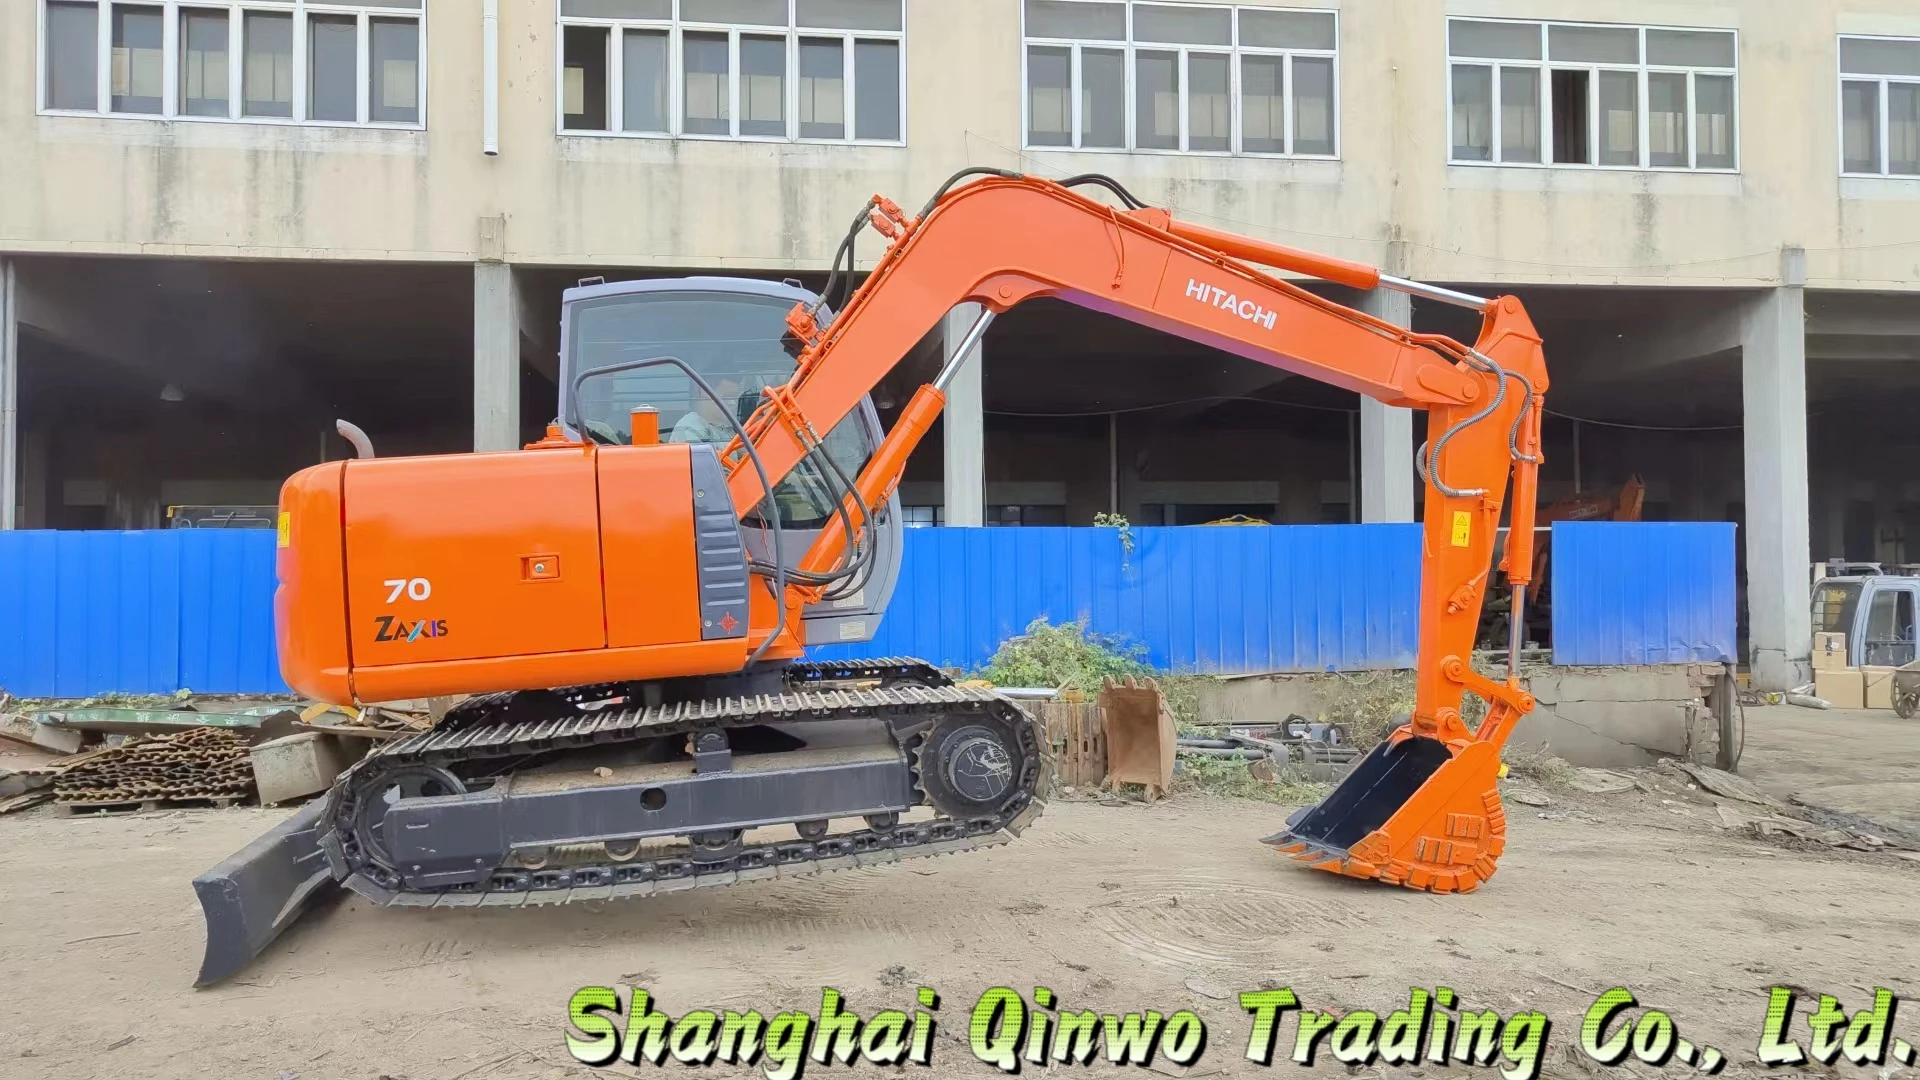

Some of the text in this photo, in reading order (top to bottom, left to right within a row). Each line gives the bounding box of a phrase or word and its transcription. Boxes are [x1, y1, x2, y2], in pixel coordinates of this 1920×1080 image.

[1185, 278, 1278, 331] HITACHI
[383, 577, 432, 604] 70
[374, 615, 449, 643] ZAXIS
